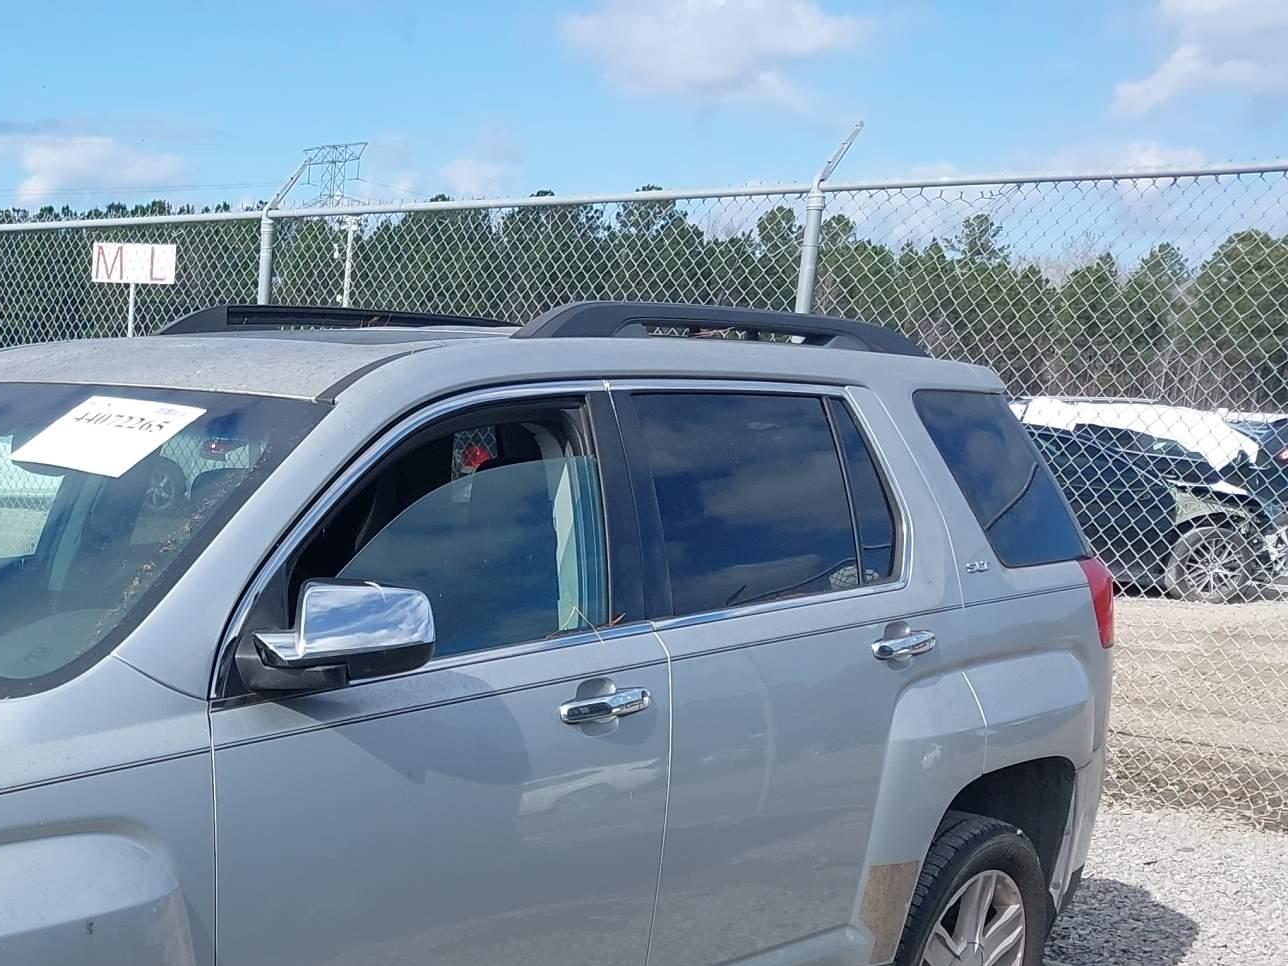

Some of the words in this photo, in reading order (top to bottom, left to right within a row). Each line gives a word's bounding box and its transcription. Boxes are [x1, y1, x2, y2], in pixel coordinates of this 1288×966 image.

[95, 245, 123, 281] M
[149, 246, 166, 281] L
[74, 412, 171, 432] 44072265
